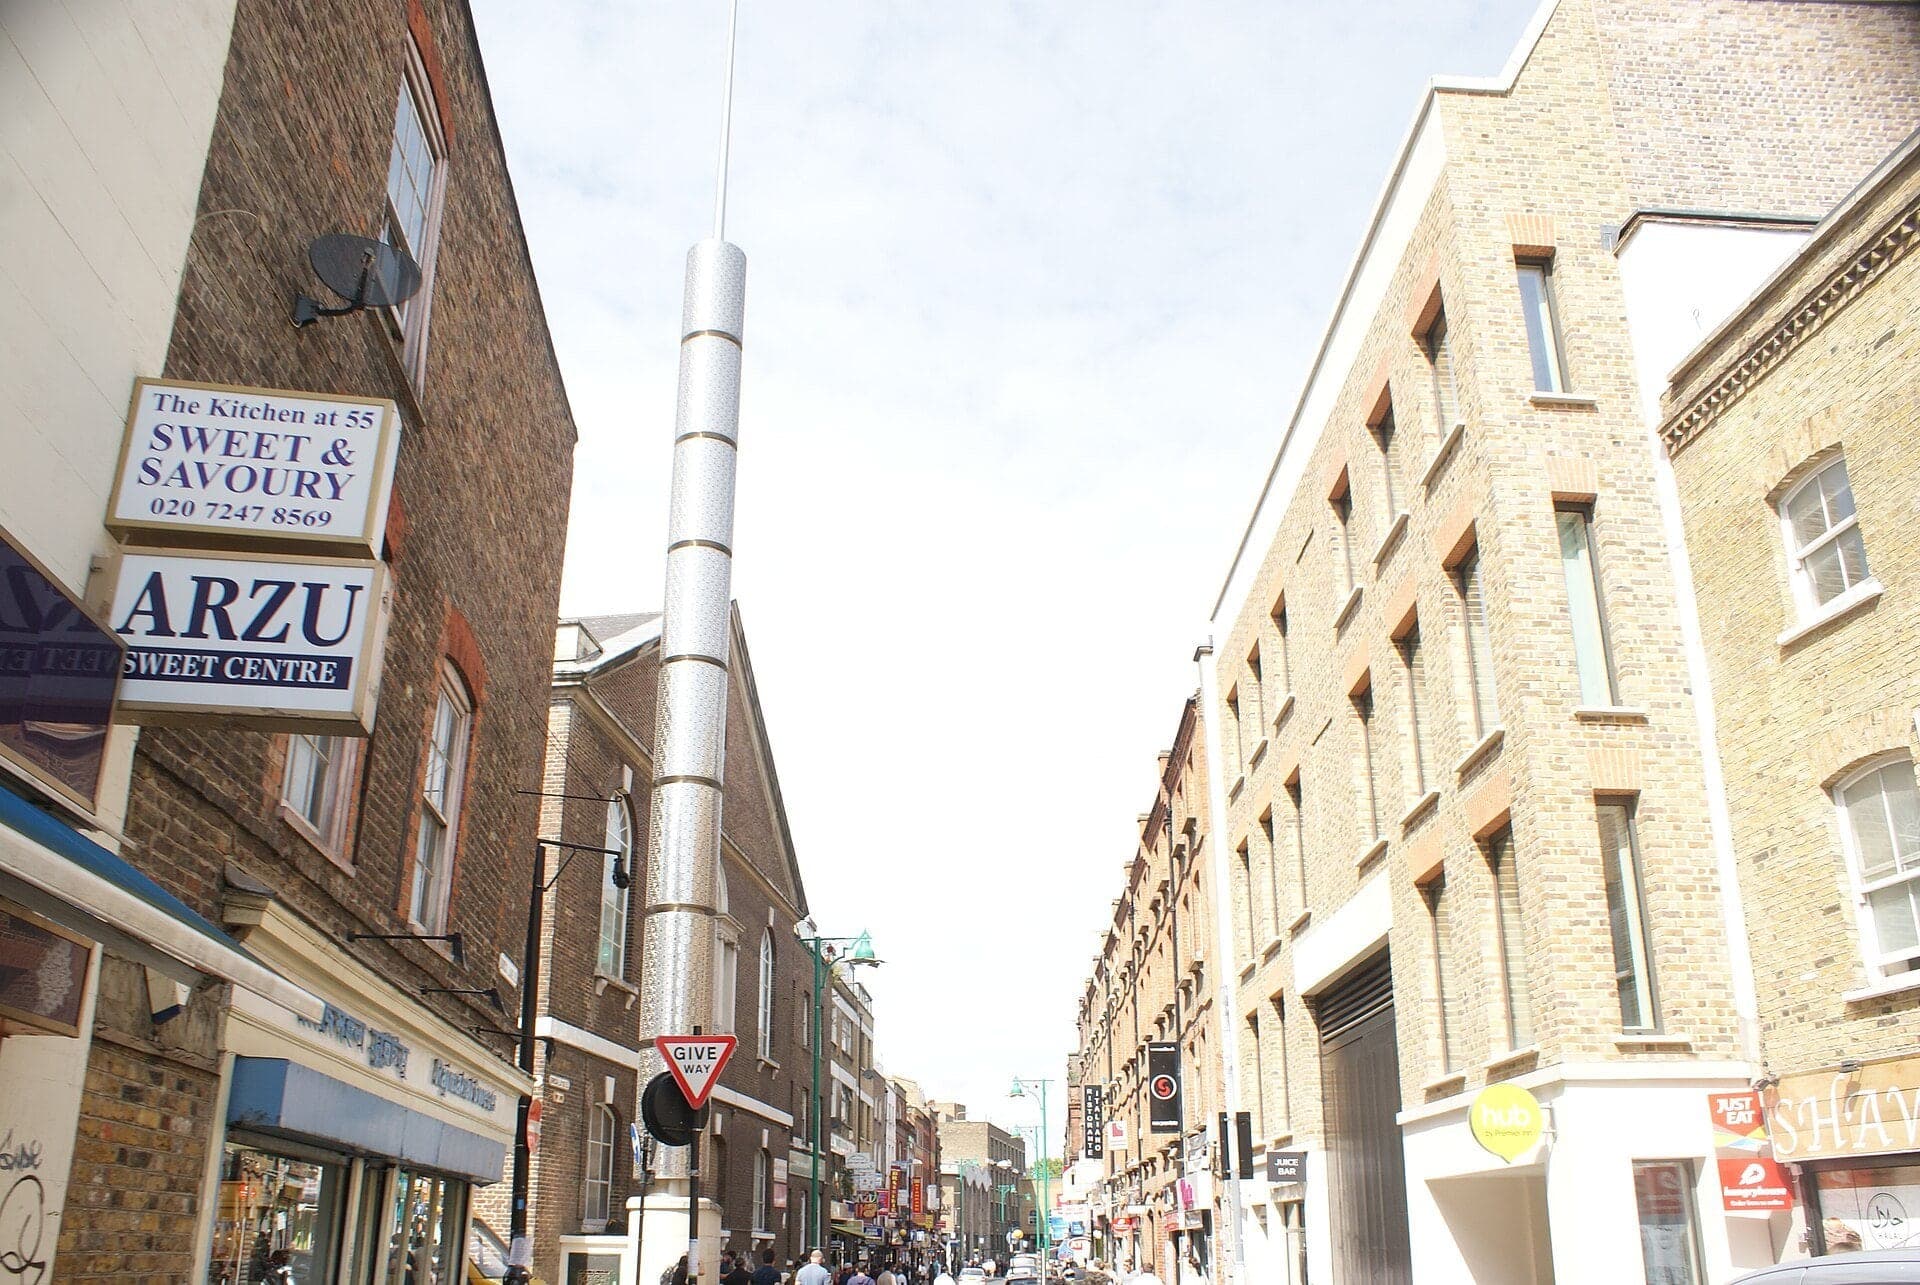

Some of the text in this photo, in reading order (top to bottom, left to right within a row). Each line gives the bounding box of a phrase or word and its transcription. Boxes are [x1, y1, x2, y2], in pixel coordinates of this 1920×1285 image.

[154, 393, 374, 429] The Kitchen at 55
[150, 423, 356, 467] SWEET &
[137, 457, 356, 501] SAVOURY
[150, 498, 332, 527] 020 7247 8569
[116, 571, 364, 647] ARZU
[123, 650, 338, 683] SWEET CENTRE
[674, 1046, 717, 1060] GIVE
[684, 1064, 711, 1074] WAY
[1481, 1103, 1530, 1127] hub
[1716, 1096, 1753, 1114] JUST
[1726, 1110, 1756, 1125] EAT
[1086, 1088, 1094, 1156] RISTORANTE
[1094, 1090, 1102, 1152] ITALIANO
[1274, 1158, 1299, 1167] JUICE
[1278, 1167, 1297, 1176] BAR
